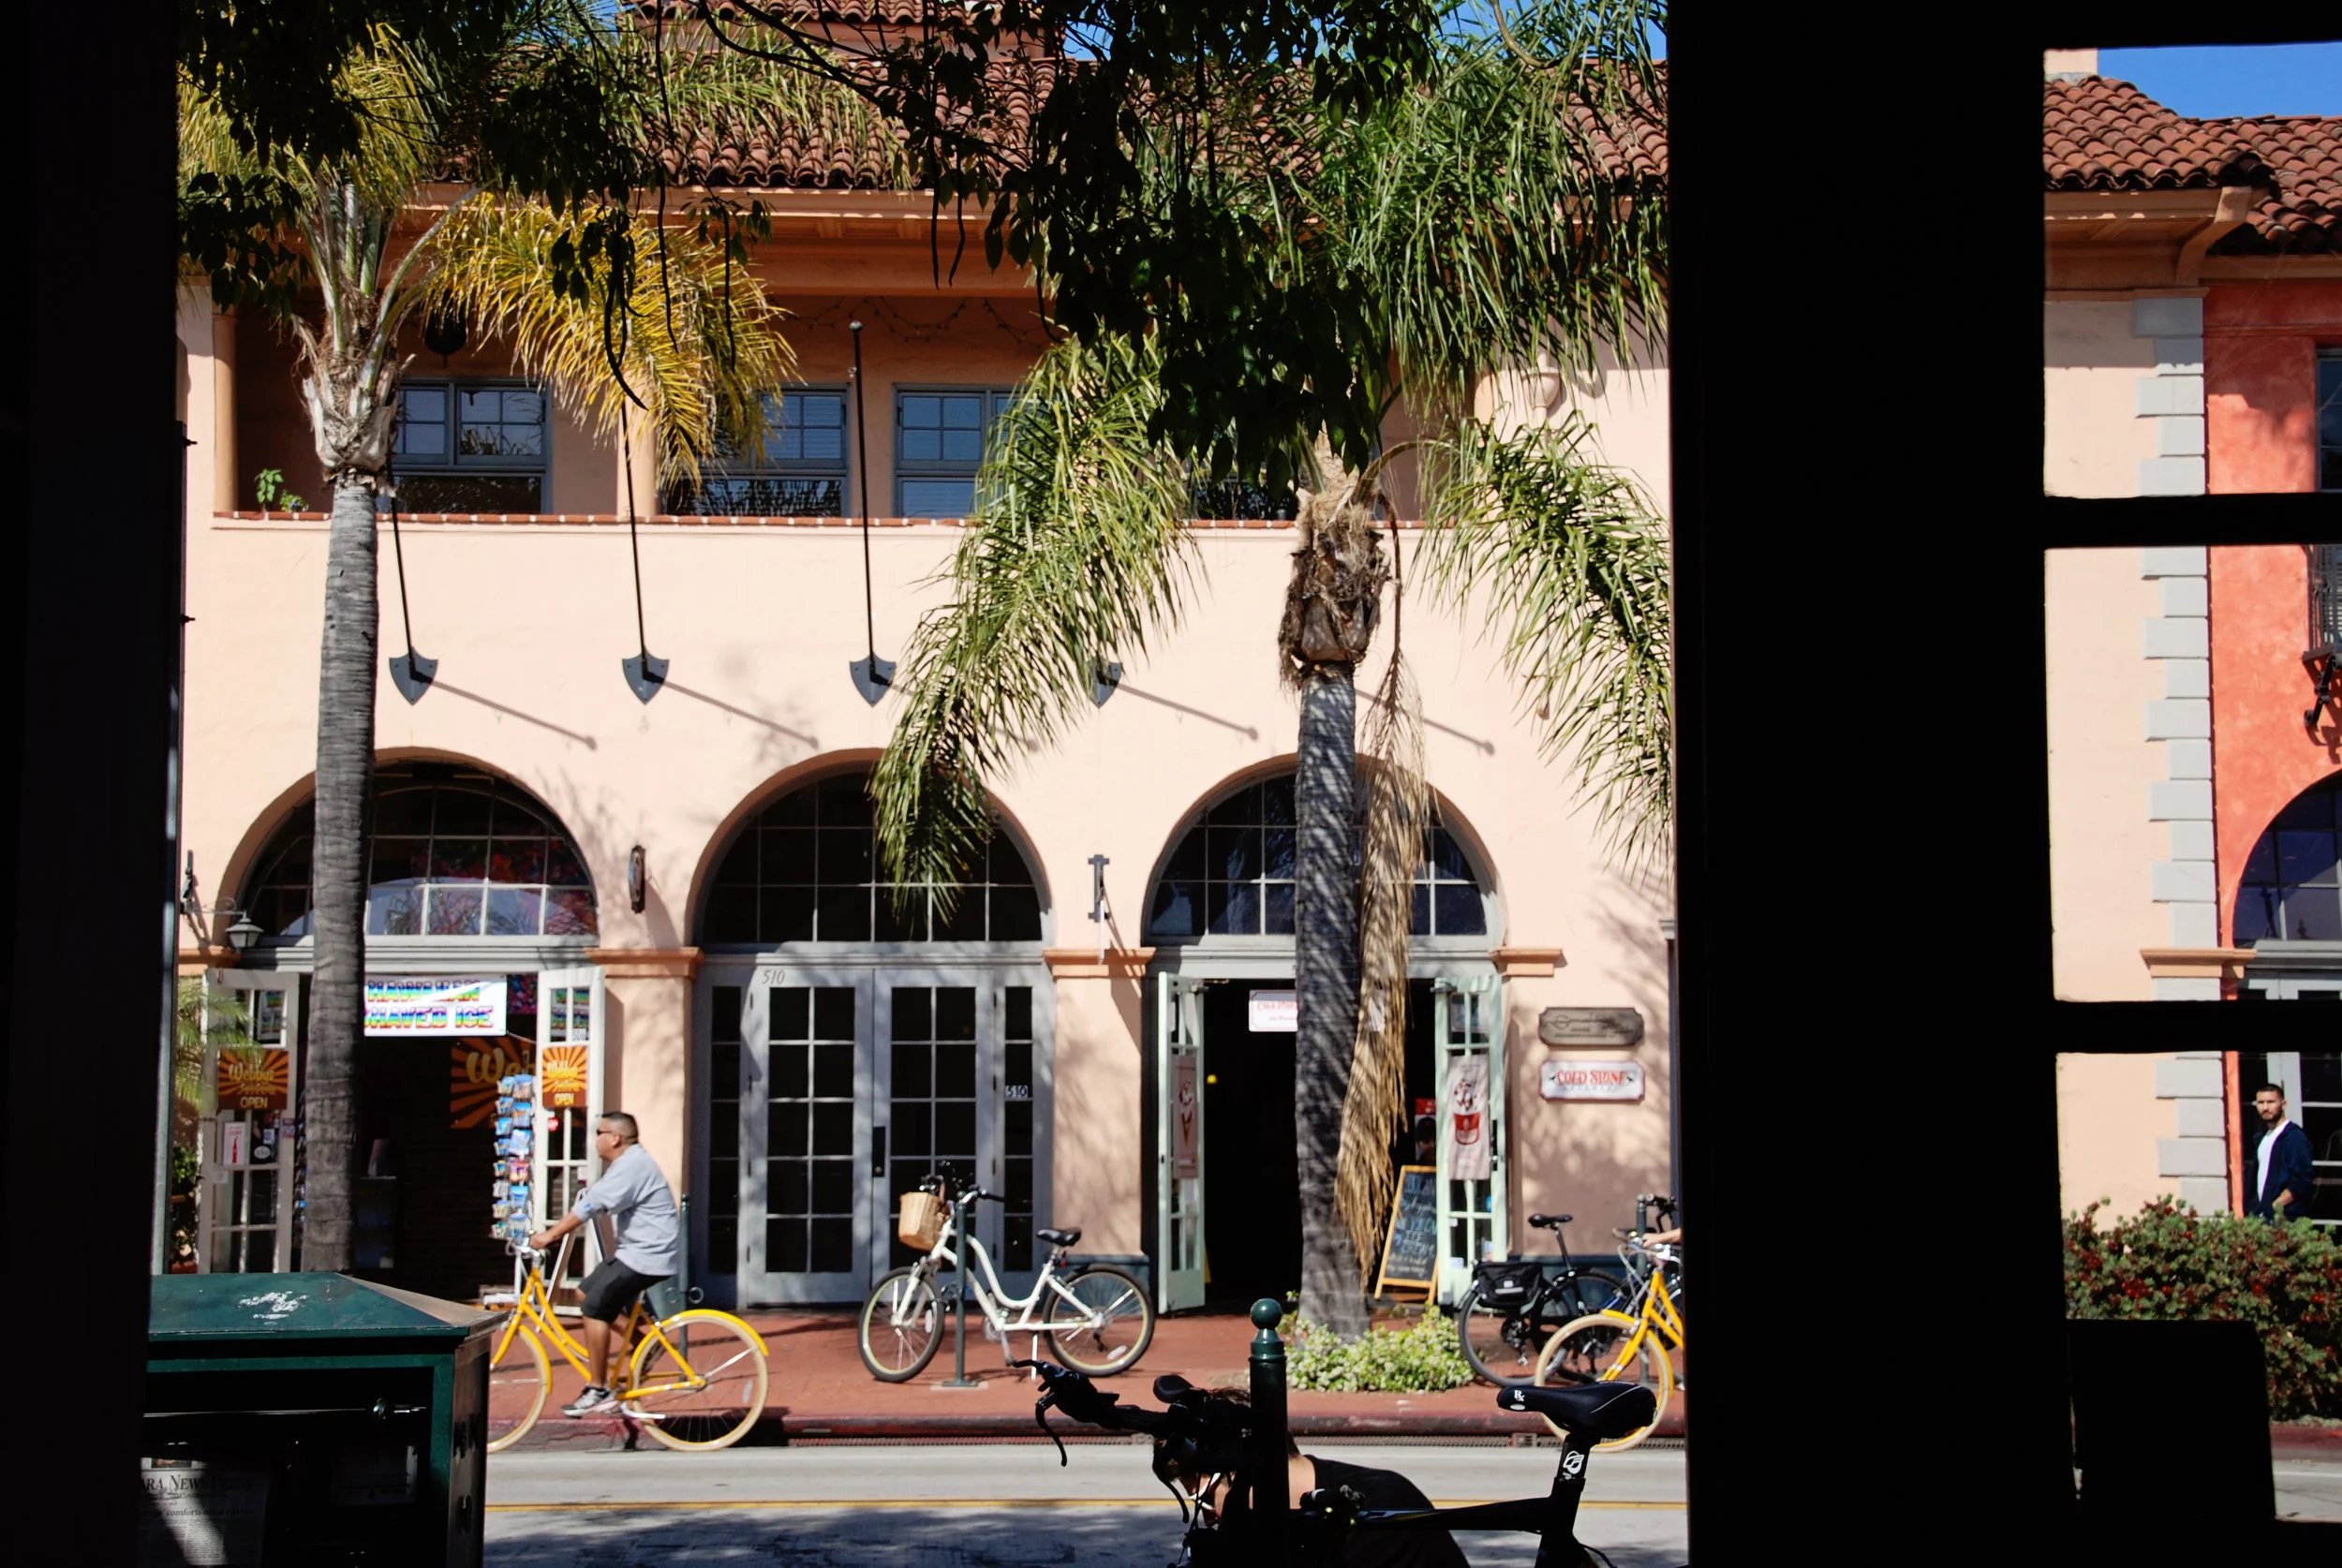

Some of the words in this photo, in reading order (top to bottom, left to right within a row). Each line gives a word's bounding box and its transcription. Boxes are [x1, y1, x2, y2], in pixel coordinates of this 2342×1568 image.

[763, 969, 785, 984] 510
[455, 1007, 494, 1028] ICE
[1556, 1071, 1587, 1087] COLD
[1590, 1070, 1626, 1087] STONE
[1006, 1085, 1027, 1097] 510
[240, 1096, 268, 1109] OPEN
[554, 1093, 574, 1106] OPEN
[166, 1507, 201, 1516] comforts
